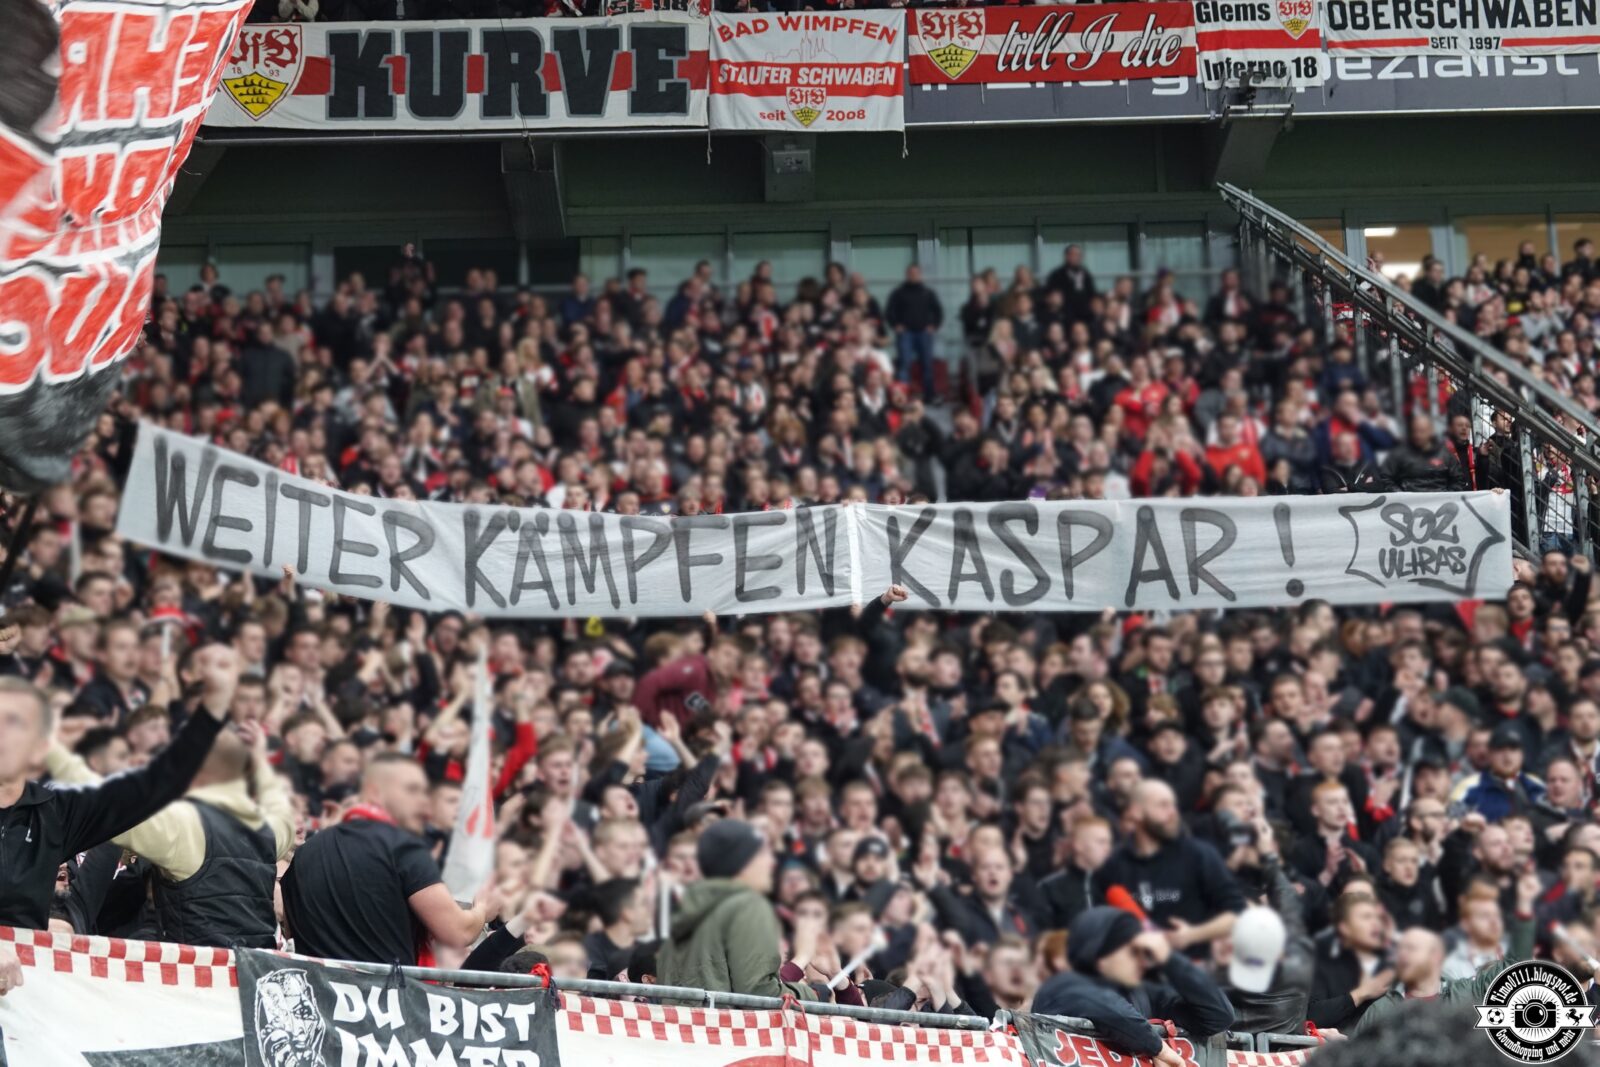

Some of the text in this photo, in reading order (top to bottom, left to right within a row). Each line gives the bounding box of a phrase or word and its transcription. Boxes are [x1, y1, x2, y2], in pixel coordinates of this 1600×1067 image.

[1195, 0, 1271, 23] Glems
[1328, 0, 1597, 31] OBERSCHWABEN
[718, 15, 897, 44] BAD WIMPFEN
[996, 11, 1074, 72] till
[1120, 13, 1182, 69] die
[1431, 37, 1500, 50] SEIT 1997
[325, 22, 690, 121] KURVE
[718, 64, 896, 86] STAUFER SCHWABEN
[1292, 56, 1318, 79] 18
[759, 109, 866, 121] seit 2008
[152, 434, 433, 600] WEITER
[463, 505, 837, 609] KÄMPFEN
[886, 504, 1236, 608] KASPAR
[1379, 545, 1466, 579] ULTRAS
[329, 981, 535, 1042] DU BIST
